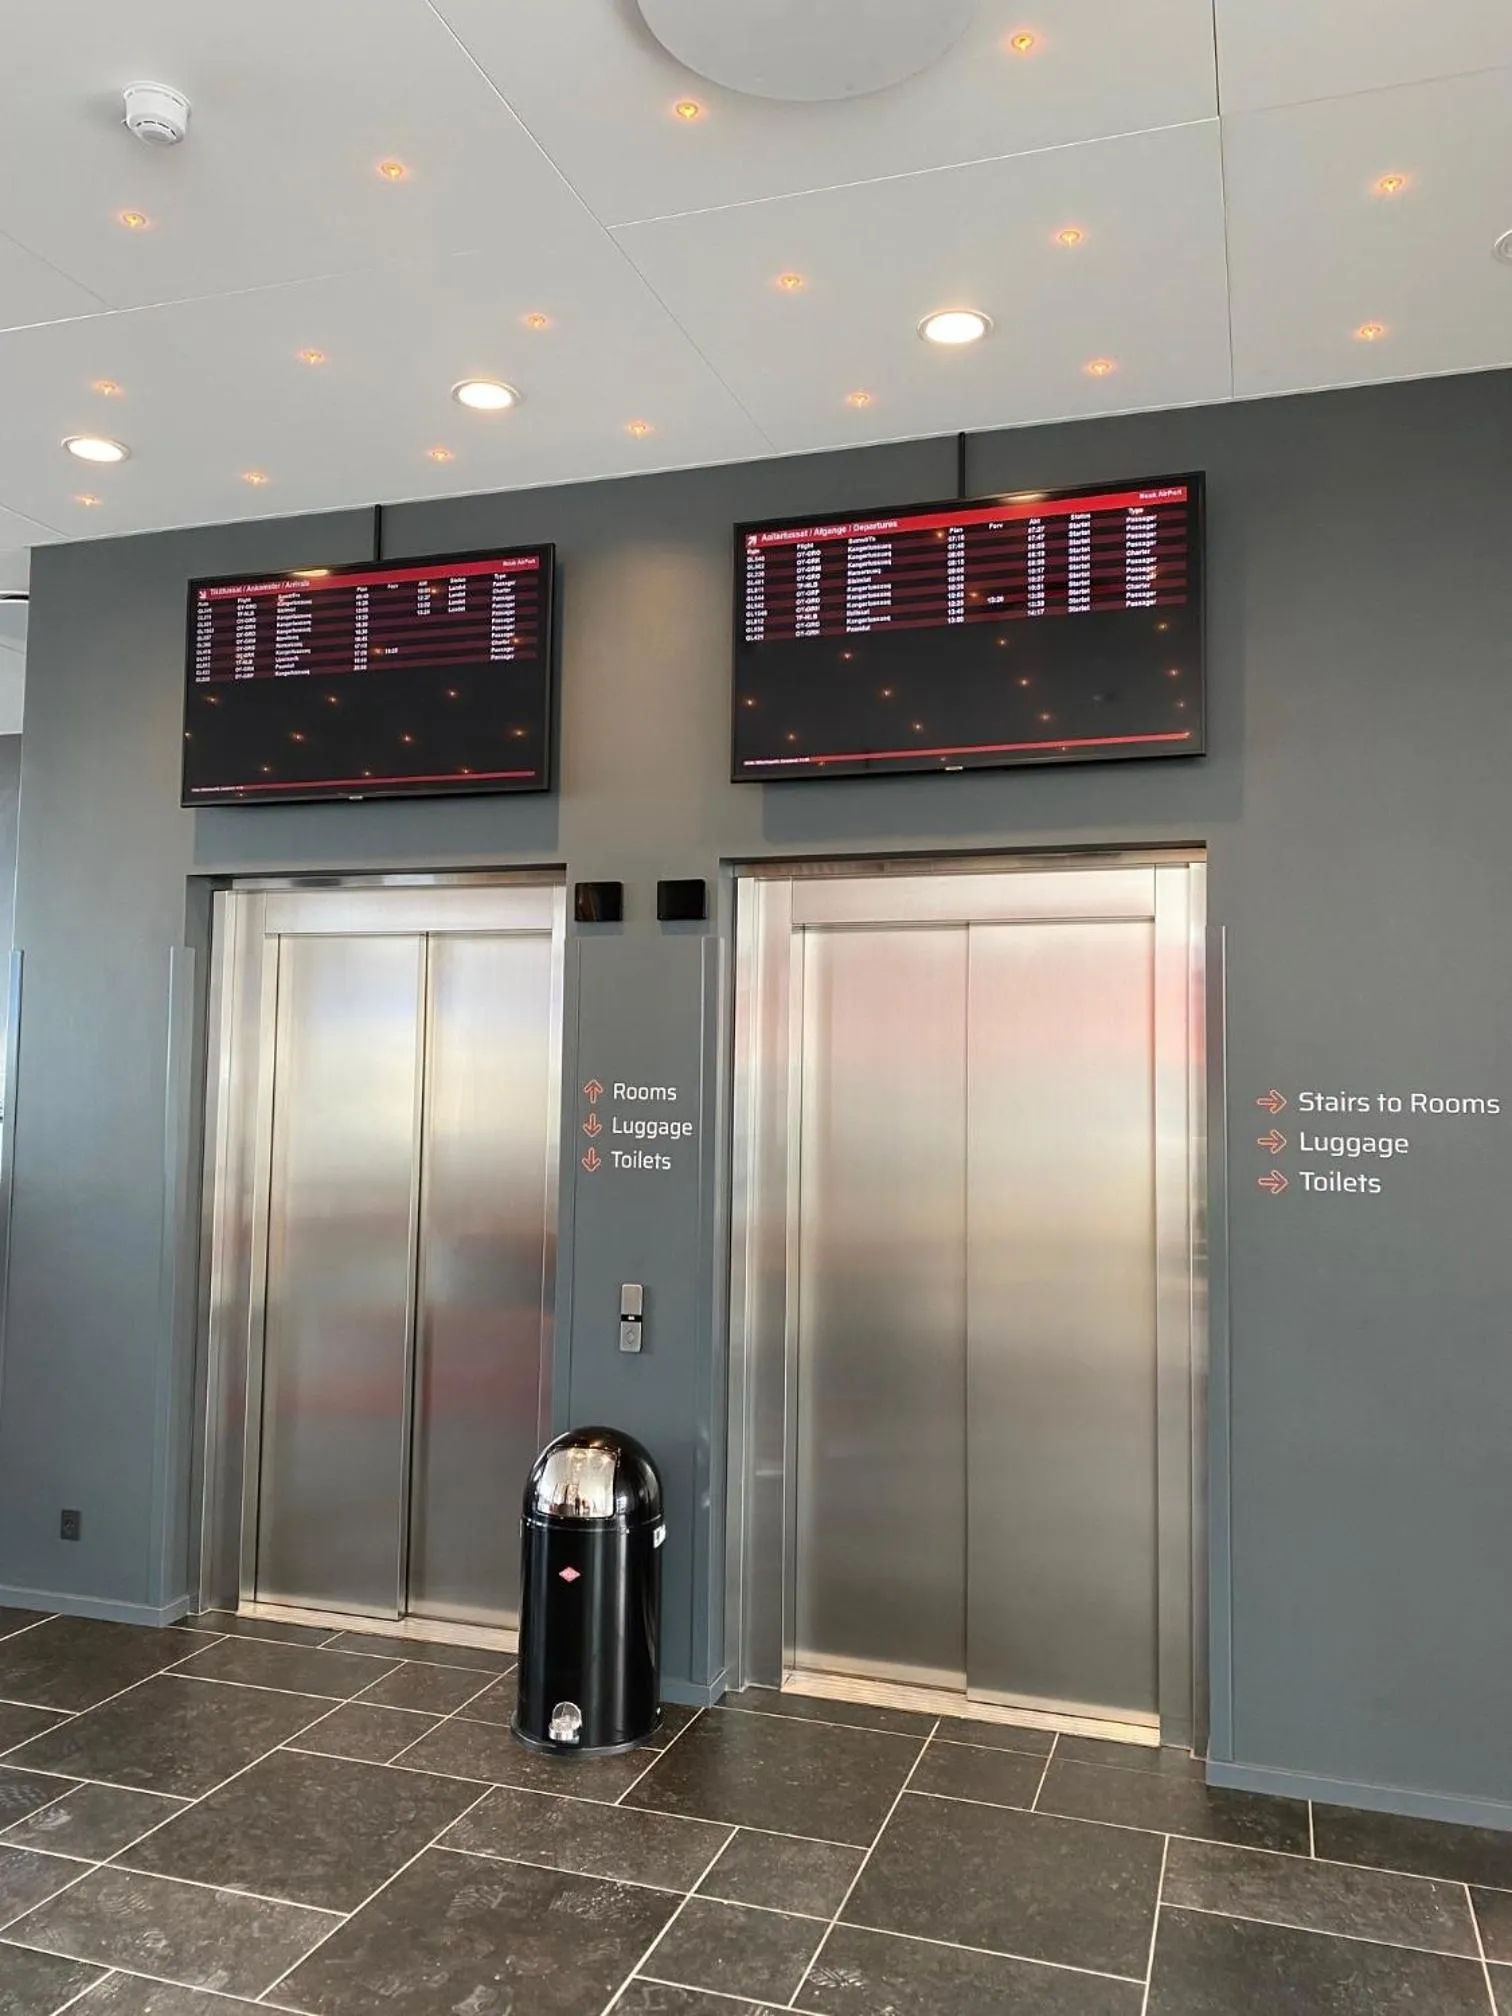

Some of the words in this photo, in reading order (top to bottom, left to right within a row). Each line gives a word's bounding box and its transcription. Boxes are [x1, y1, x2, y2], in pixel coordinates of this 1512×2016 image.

[853, 521, 898, 532] Departures
[613, 1082, 677, 1101] Rooms
[1299, 1091, 1370, 1112] Stairs
[1377, 1092, 1402, 1113] to
[1411, 1093, 1500, 1114] Rooms
[612, 1116, 693, 1139] Luggage
[1300, 1131, 1409, 1158] Luggage
[611, 1150, 672, 1170] Toilets
[1299, 1171, 1382, 1194] Toilets
